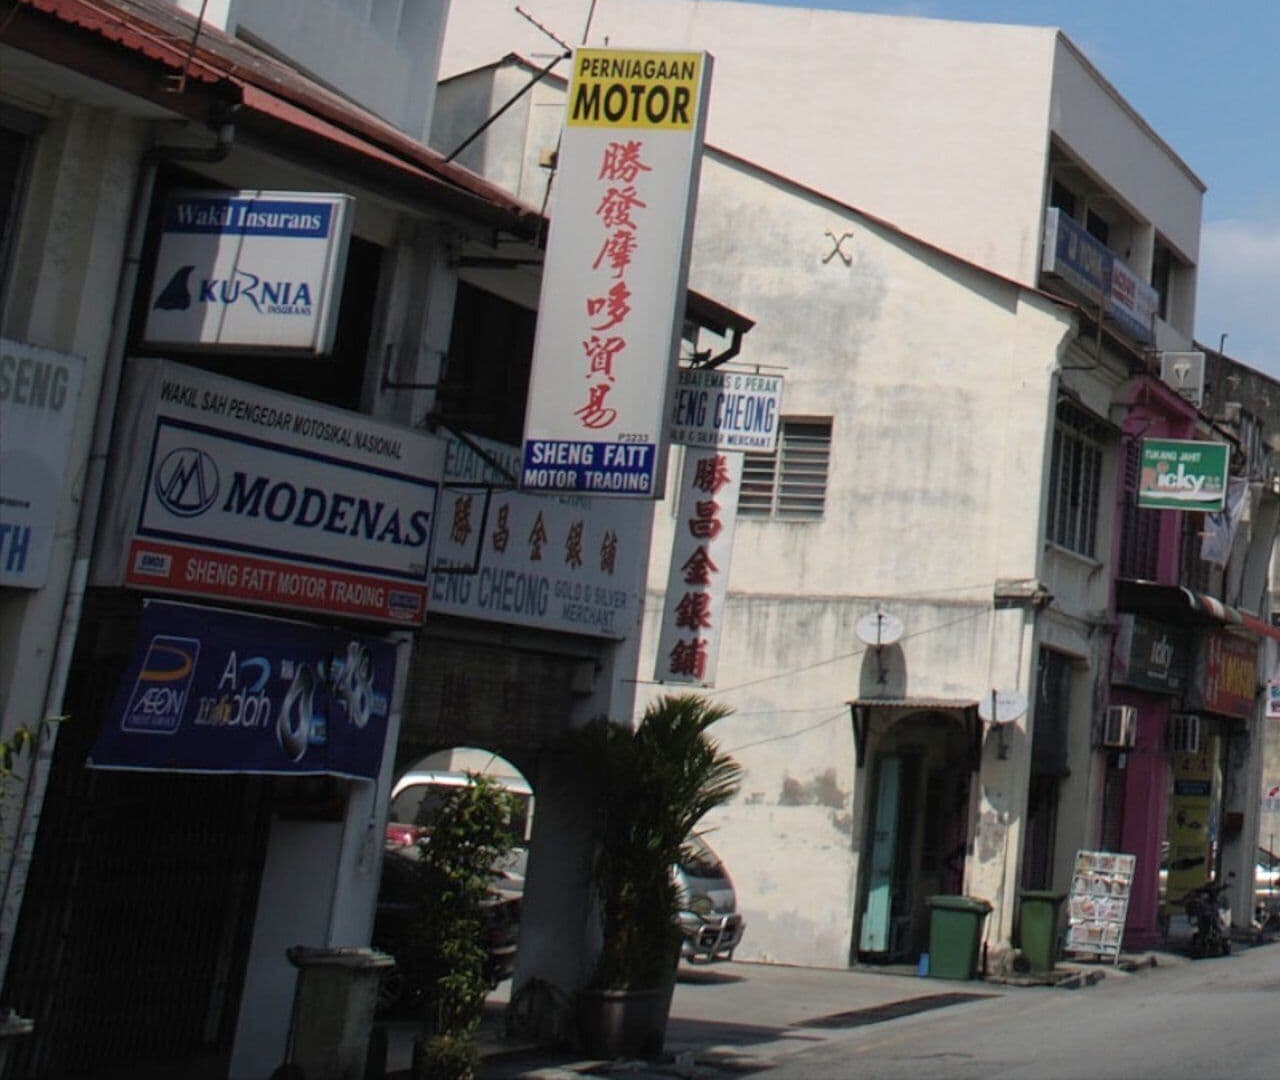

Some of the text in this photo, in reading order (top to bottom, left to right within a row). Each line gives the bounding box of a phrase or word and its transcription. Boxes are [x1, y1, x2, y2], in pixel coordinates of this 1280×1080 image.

[580, 57, 696, 81] PERNIAGAAN
[572, 83, 691, 124] MOTOR
[176, 204, 322, 231] Wakil Insurans
[199, 270, 313, 313] KURNIA
[160, 379, 402, 459] WAKIL SAH PENGEDAR MOTOSIKAL NASIONAL
[712, 392, 777, 433] CHEONG
[531, 442, 649, 468] SHENG FATT
[1144, 449, 1178, 461] TUKANG
[523, 469, 650, 490] MOTOR TRADING
[1139, 461, 1205, 494] Ricky
[223, 471, 431, 548] MODENAS
[185, 558, 239, 588] SHENG
[239, 566, 277, 593] FATT
[277, 571, 326, 601] MOTOR
[329, 579, 385, 609] TRADING
[477, 566, 550, 617] CHEONG
